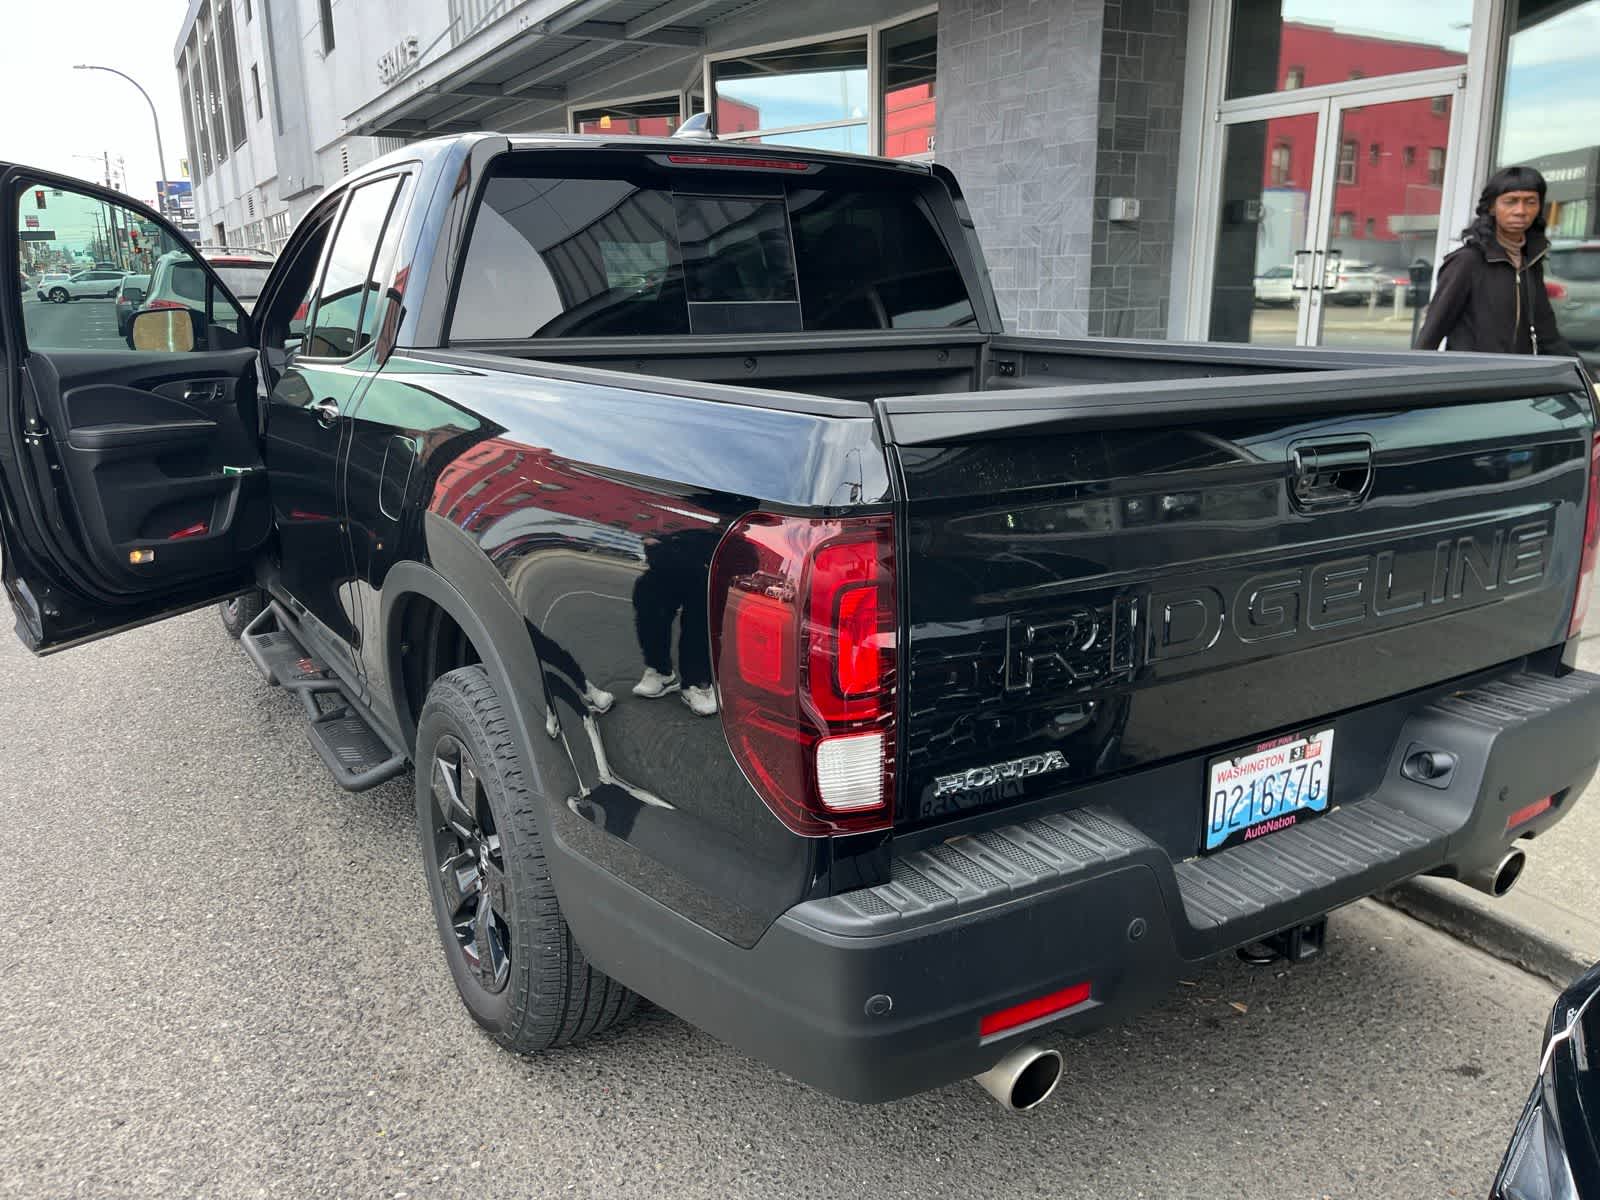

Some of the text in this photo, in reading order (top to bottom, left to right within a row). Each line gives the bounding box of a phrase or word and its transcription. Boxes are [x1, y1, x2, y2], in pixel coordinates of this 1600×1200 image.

[1004, 519, 1549, 692] RIDGELINE
[933, 750, 1070, 797] HONDA
[1217, 753, 1285, 783] WASHINGTON
[1211, 759, 1323, 835] D21677G
[1244, 814, 1297, 841] AutoNation
